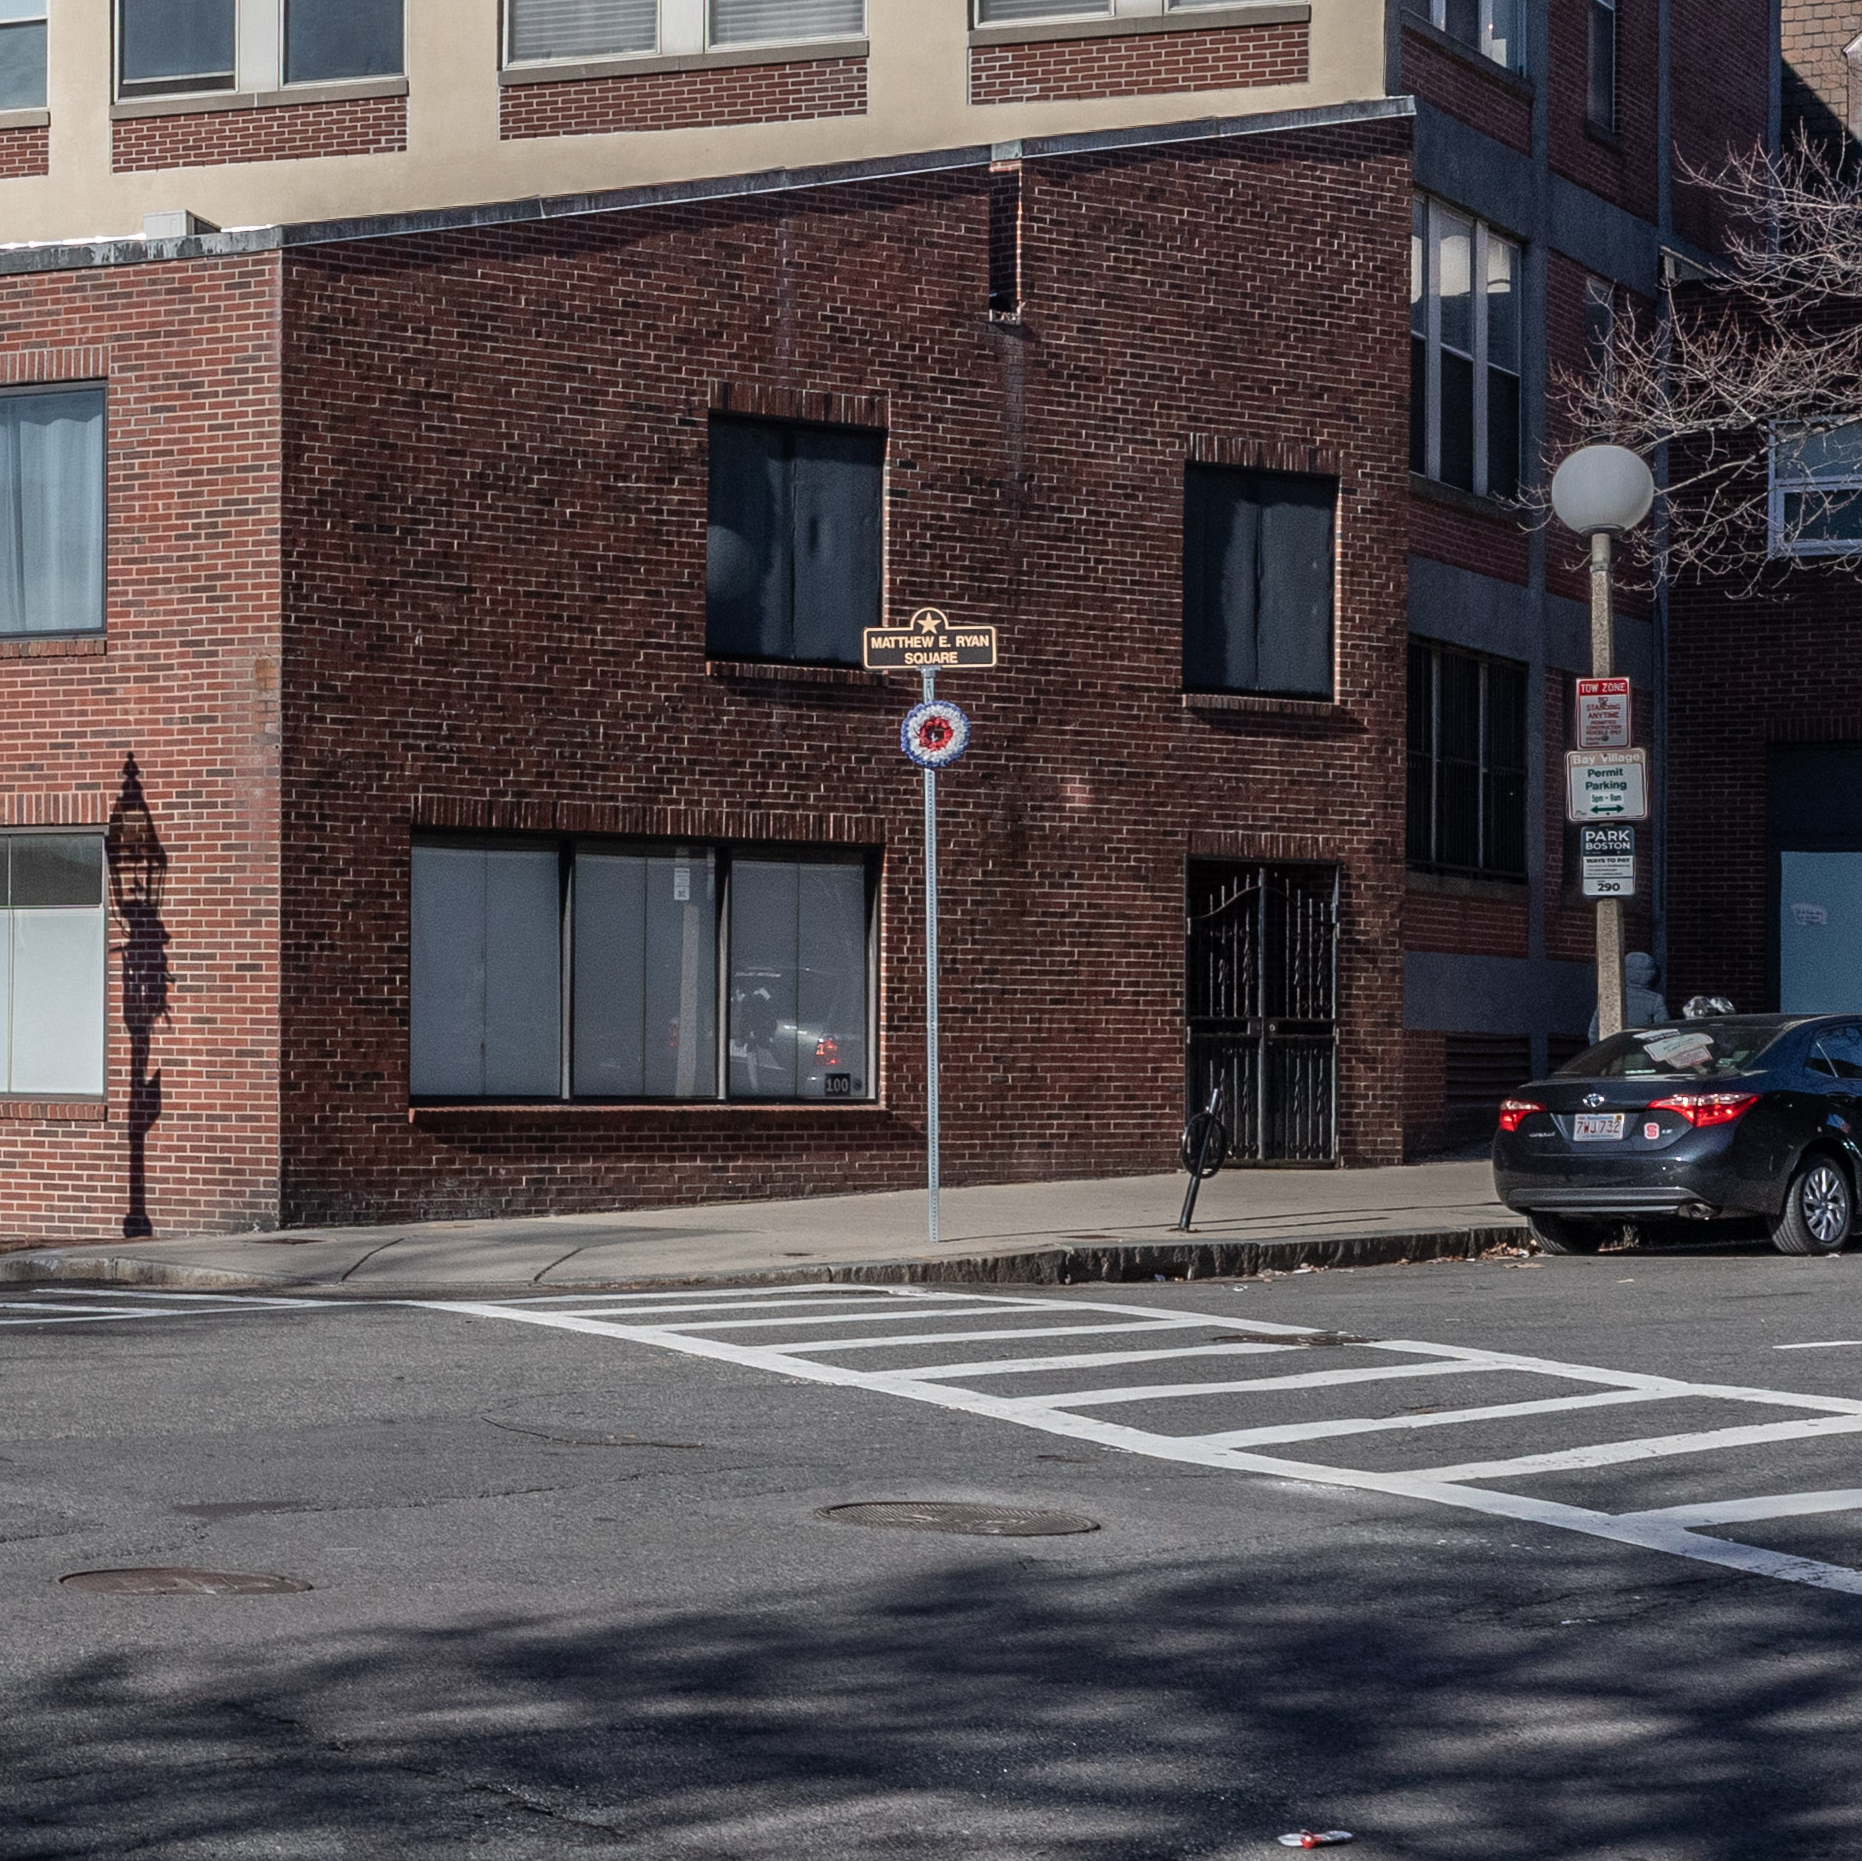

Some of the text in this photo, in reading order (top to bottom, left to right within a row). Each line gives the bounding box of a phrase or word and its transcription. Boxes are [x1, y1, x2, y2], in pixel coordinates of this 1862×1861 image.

[871, 635, 990, 649] MATTHEW E. RYAN
[904, 652, 958, 664] SQUARE
[1581, 682, 1626, 693] TOW ZONE
[1573, 753, 1640, 765] Bay Village
[1588, 768, 1623, 777] Permit
[1585, 781, 1627, 791] Parking
[1585, 830, 1630, 842] PARK
[1585, 842, 1631, 850] BOSTON
[1597, 883, 1621, 892] 290
[826, 1077, 849, 1092] 100
[1599, 1120, 1620, 1133] 732
